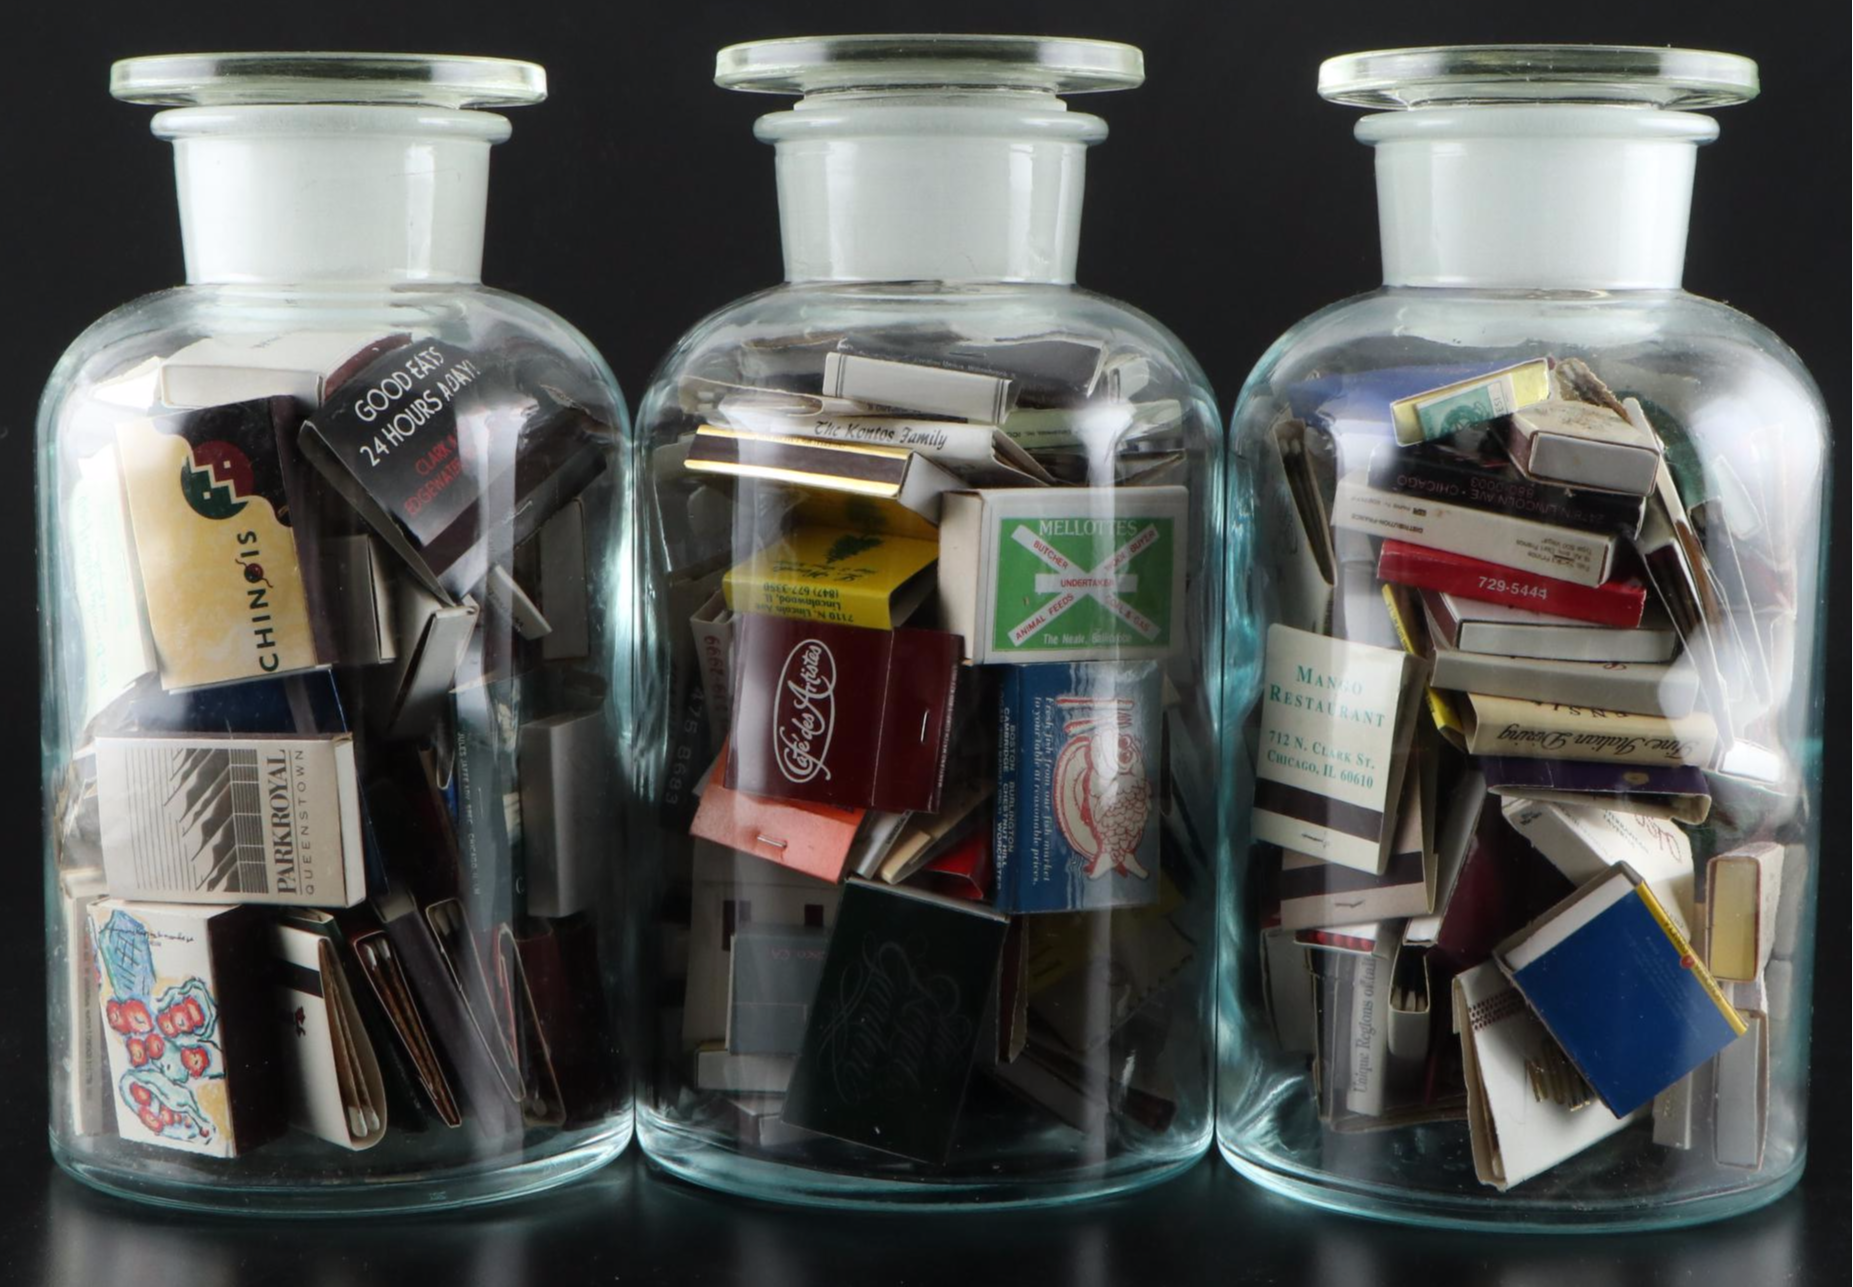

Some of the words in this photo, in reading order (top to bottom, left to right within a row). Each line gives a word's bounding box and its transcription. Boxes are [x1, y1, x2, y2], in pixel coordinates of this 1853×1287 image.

[355, 371, 412, 422] GOOD
[405, 346, 444, 379] EATS
[360, 436, 390, 467] 24
[381, 389, 443, 447] HOURS
[814, 420, 842, 436] The
[844, 422, 895, 440] Kontos
[899, 426, 949, 450] Family
[415, 442, 453, 476] CLARK
[1396, 475, 1460, 496] CHICAGO
[1470, 488, 1498, 503] AVE
[1498, 490, 1561, 518] LINCOLN
[1038, 519, 1138, 537] MELLOTTES
[1032, 539, 1069, 570] BUTCHER
[1478, 575, 1549, 600] 729-5444
[1015, 615, 1047, 641] ANIMAL
[1047, 592, 1075, 616] FEEDS
[787, 645, 831, 735] Artistes
[791, 713, 815, 740] des
[1269, 730, 1291, 747] 712
[1294, 736, 1308, 752] N.
[1496, 723, 1574, 752] Dining
[780, 726, 831, 780] Café
[1574, 732, 1646, 757] Italian
[1042, 756, 1053, 786] from
[1323, 763, 1337, 779] IL
[1340, 769, 1375, 789] 60610
[266, 749, 299, 896] PARKROYAL
[294, 749, 315, 896] QUEENSTOWN
[1357, 1000, 1374, 1048] Regions
[1353, 1050, 1371, 1095] Unique
